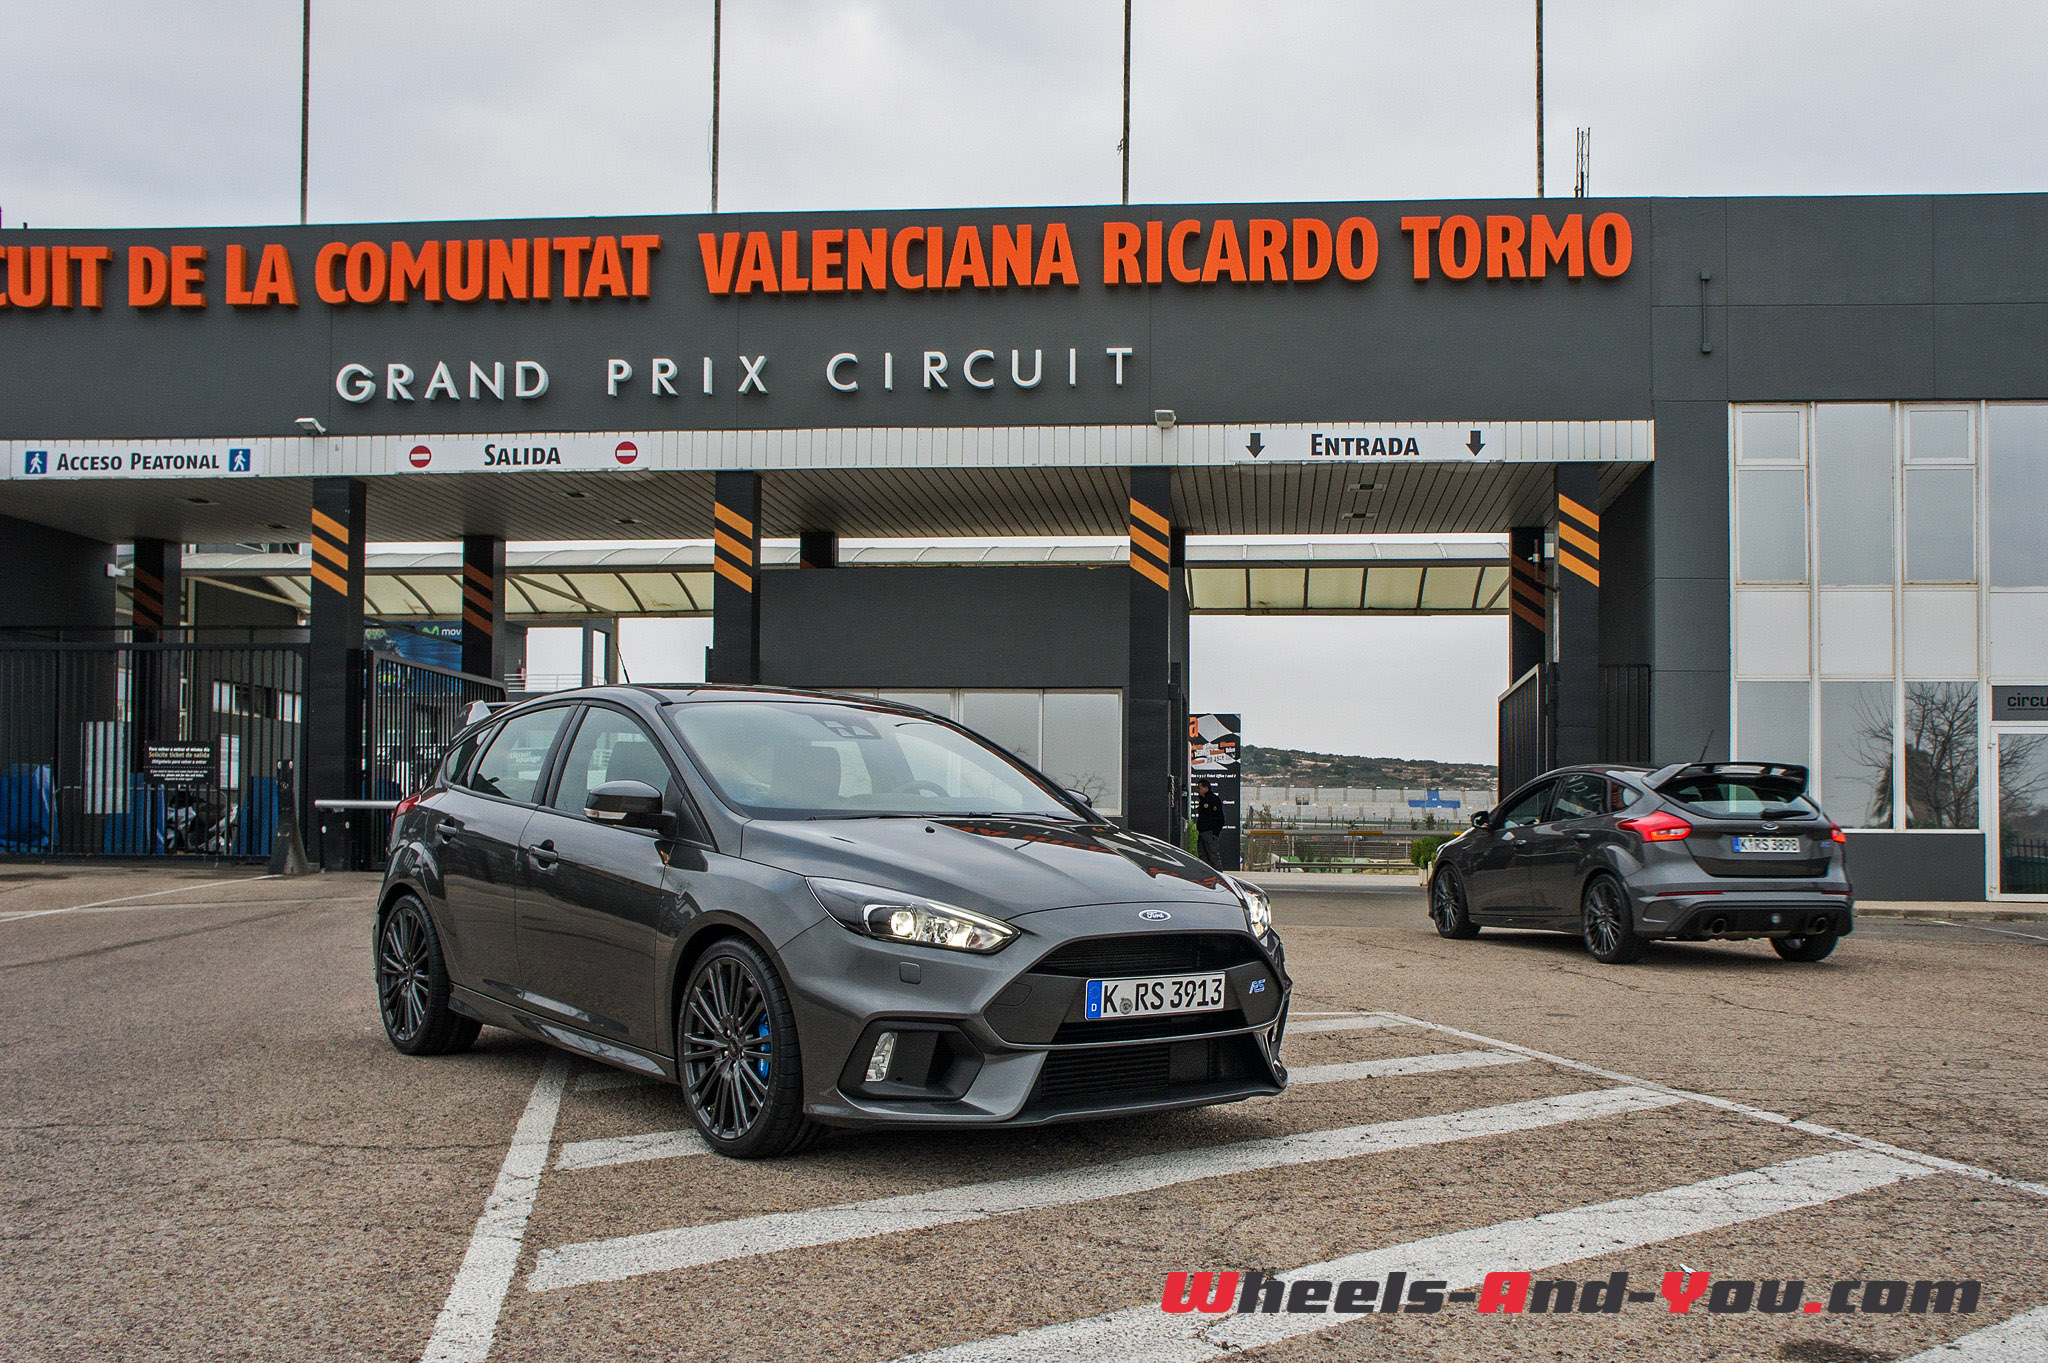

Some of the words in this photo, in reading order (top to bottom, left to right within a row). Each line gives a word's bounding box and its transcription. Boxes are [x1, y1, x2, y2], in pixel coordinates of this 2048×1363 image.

[0, 246, 113, 309] UIT
[128, 246, 208, 309] DE
[226, 244, 299, 306] LA
[314, 234, 662, 306] COMUNITAT
[698, 222, 1080, 296] VALENCIANA
[1103, 216, 1379, 287] RICARDO
[1400, 212, 1634, 282] TORMO
[335, 360, 549, 403] GRAND
[607, 355, 768, 398] PRIX
[826, 347, 1133, 392] CIRCUIT
[484, 443, 562, 466] SALIDA
[1310, 433, 1419, 456] ENTRADA
[57, 453, 122, 471] ACCESO
[130, 452, 219, 470] PEATONAL
[1103, 984, 1119, 1013] K
[1135, 981, 1165, 1011] RS
[1169, 978, 1222, 1008] 3913
[1091, 1003, 1097, 1012] D
